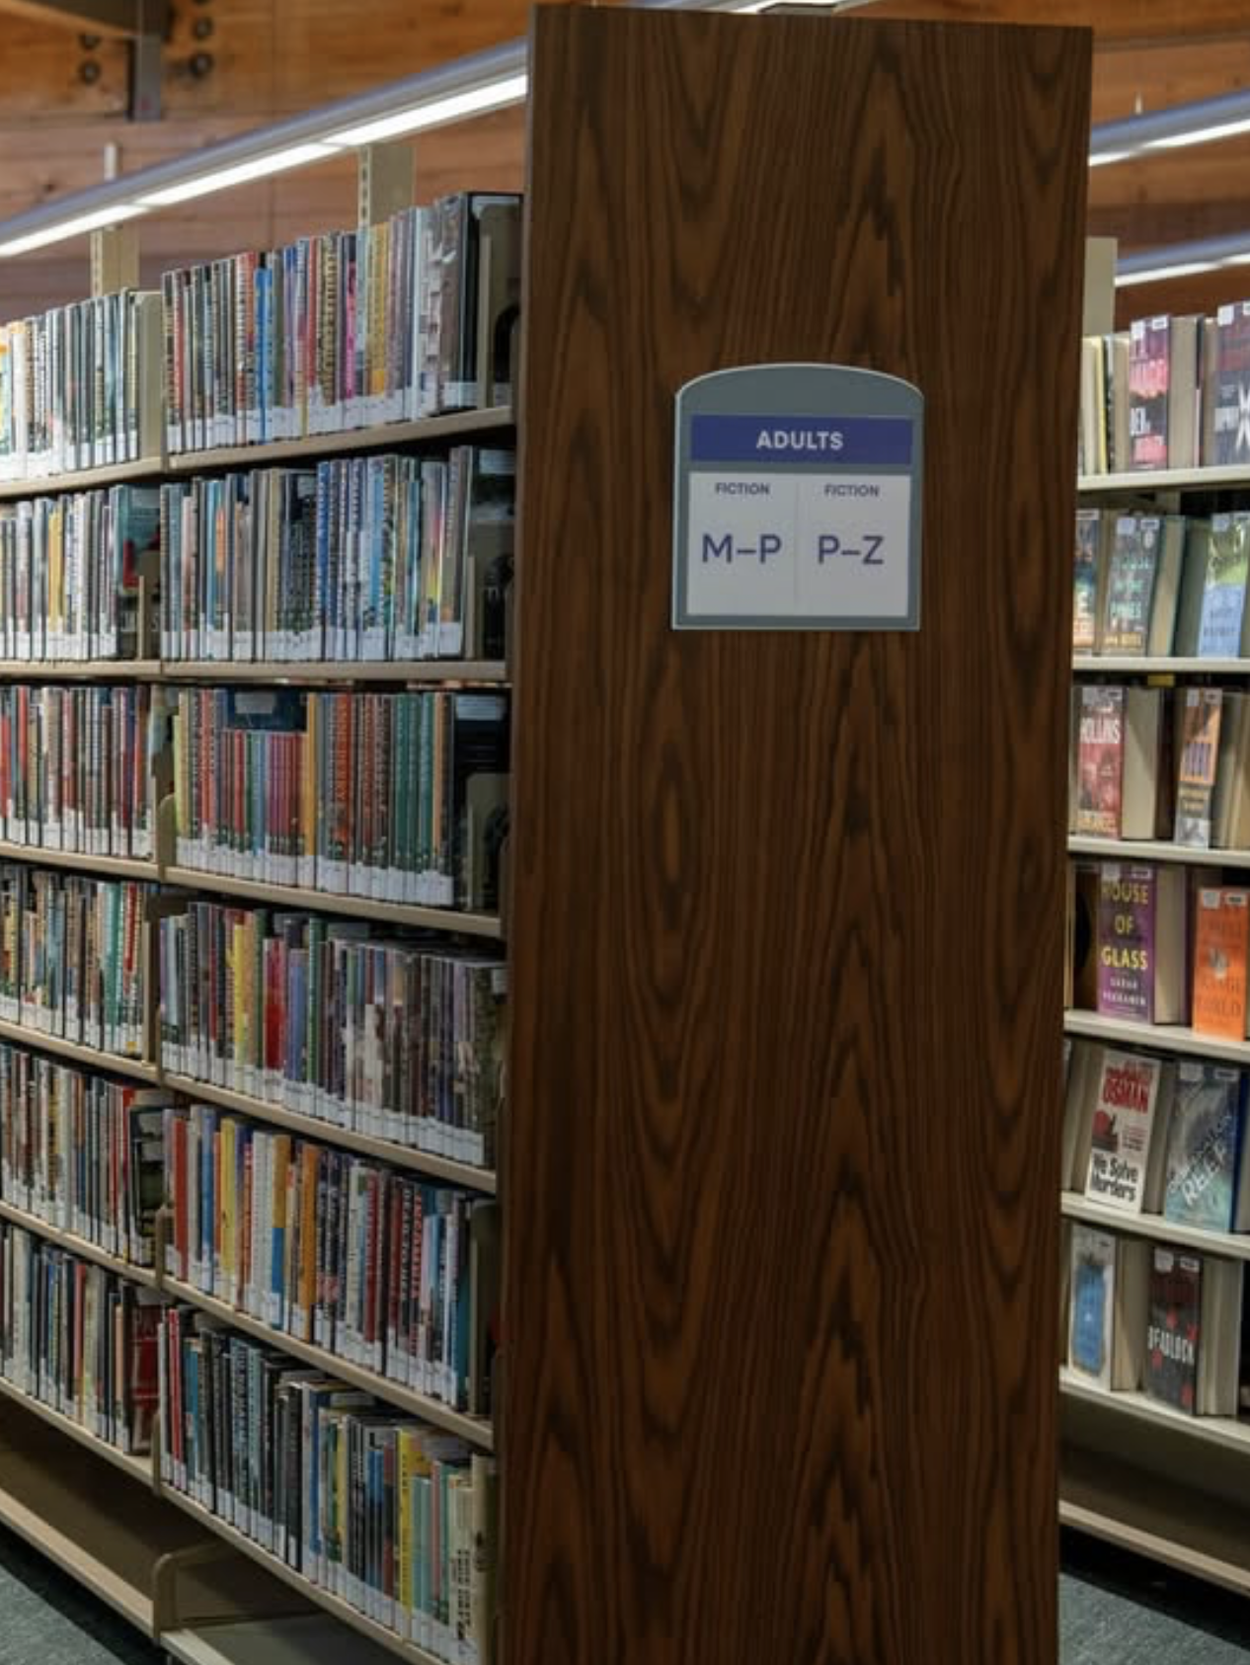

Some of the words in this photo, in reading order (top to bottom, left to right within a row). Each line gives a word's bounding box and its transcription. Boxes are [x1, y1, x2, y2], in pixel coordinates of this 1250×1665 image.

[756, 430, 844, 450] ADULTS
[715, 482, 771, 495] FICTION
[824, 484, 880, 497] FICTION
[702, 533, 782, 564] M–P
[817, 534, 885, 565] P–Z
[1115, 915, 1135, 935] OF
[1101, 946, 1149, 971] GLASS
[1110, 1157, 1139, 1184] Solve
